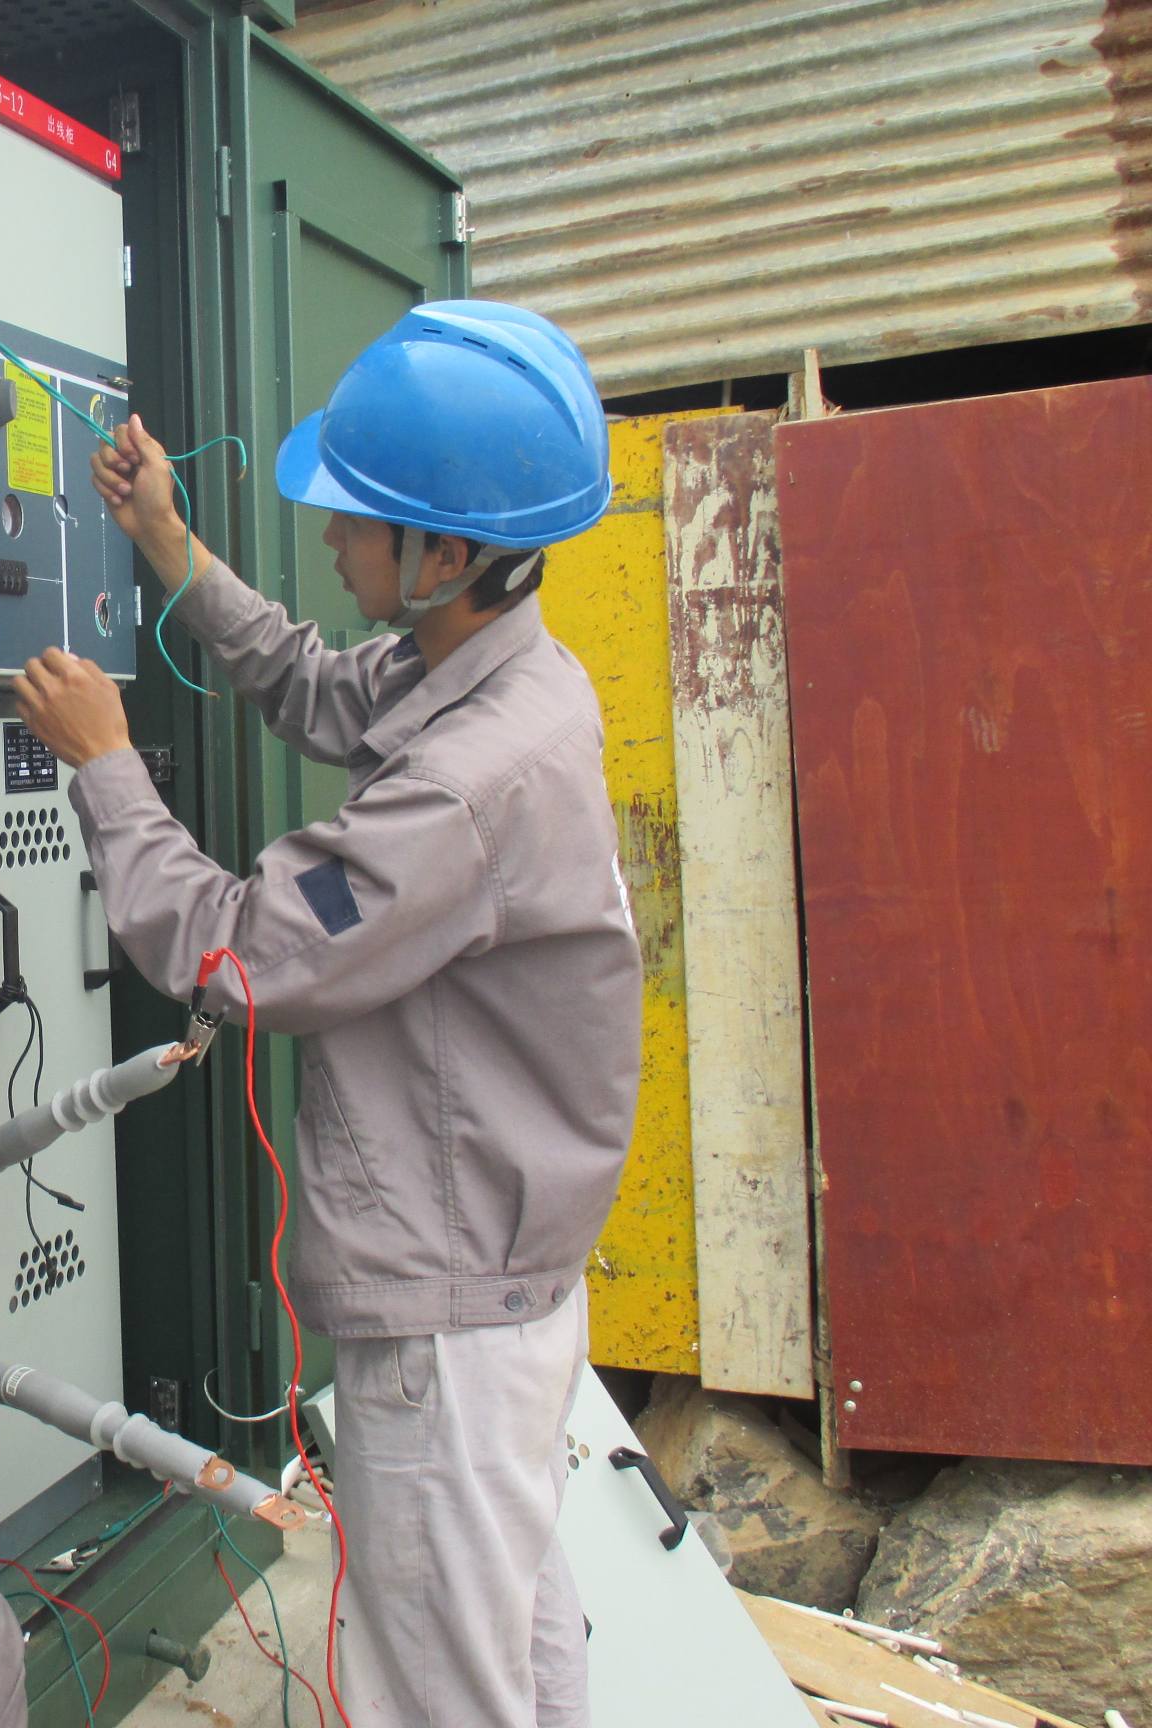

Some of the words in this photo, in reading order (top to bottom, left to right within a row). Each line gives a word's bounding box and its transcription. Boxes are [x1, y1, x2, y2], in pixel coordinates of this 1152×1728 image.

[47, 114, 74, 145] 出线柜
[105, 149, 117, 172] G4
